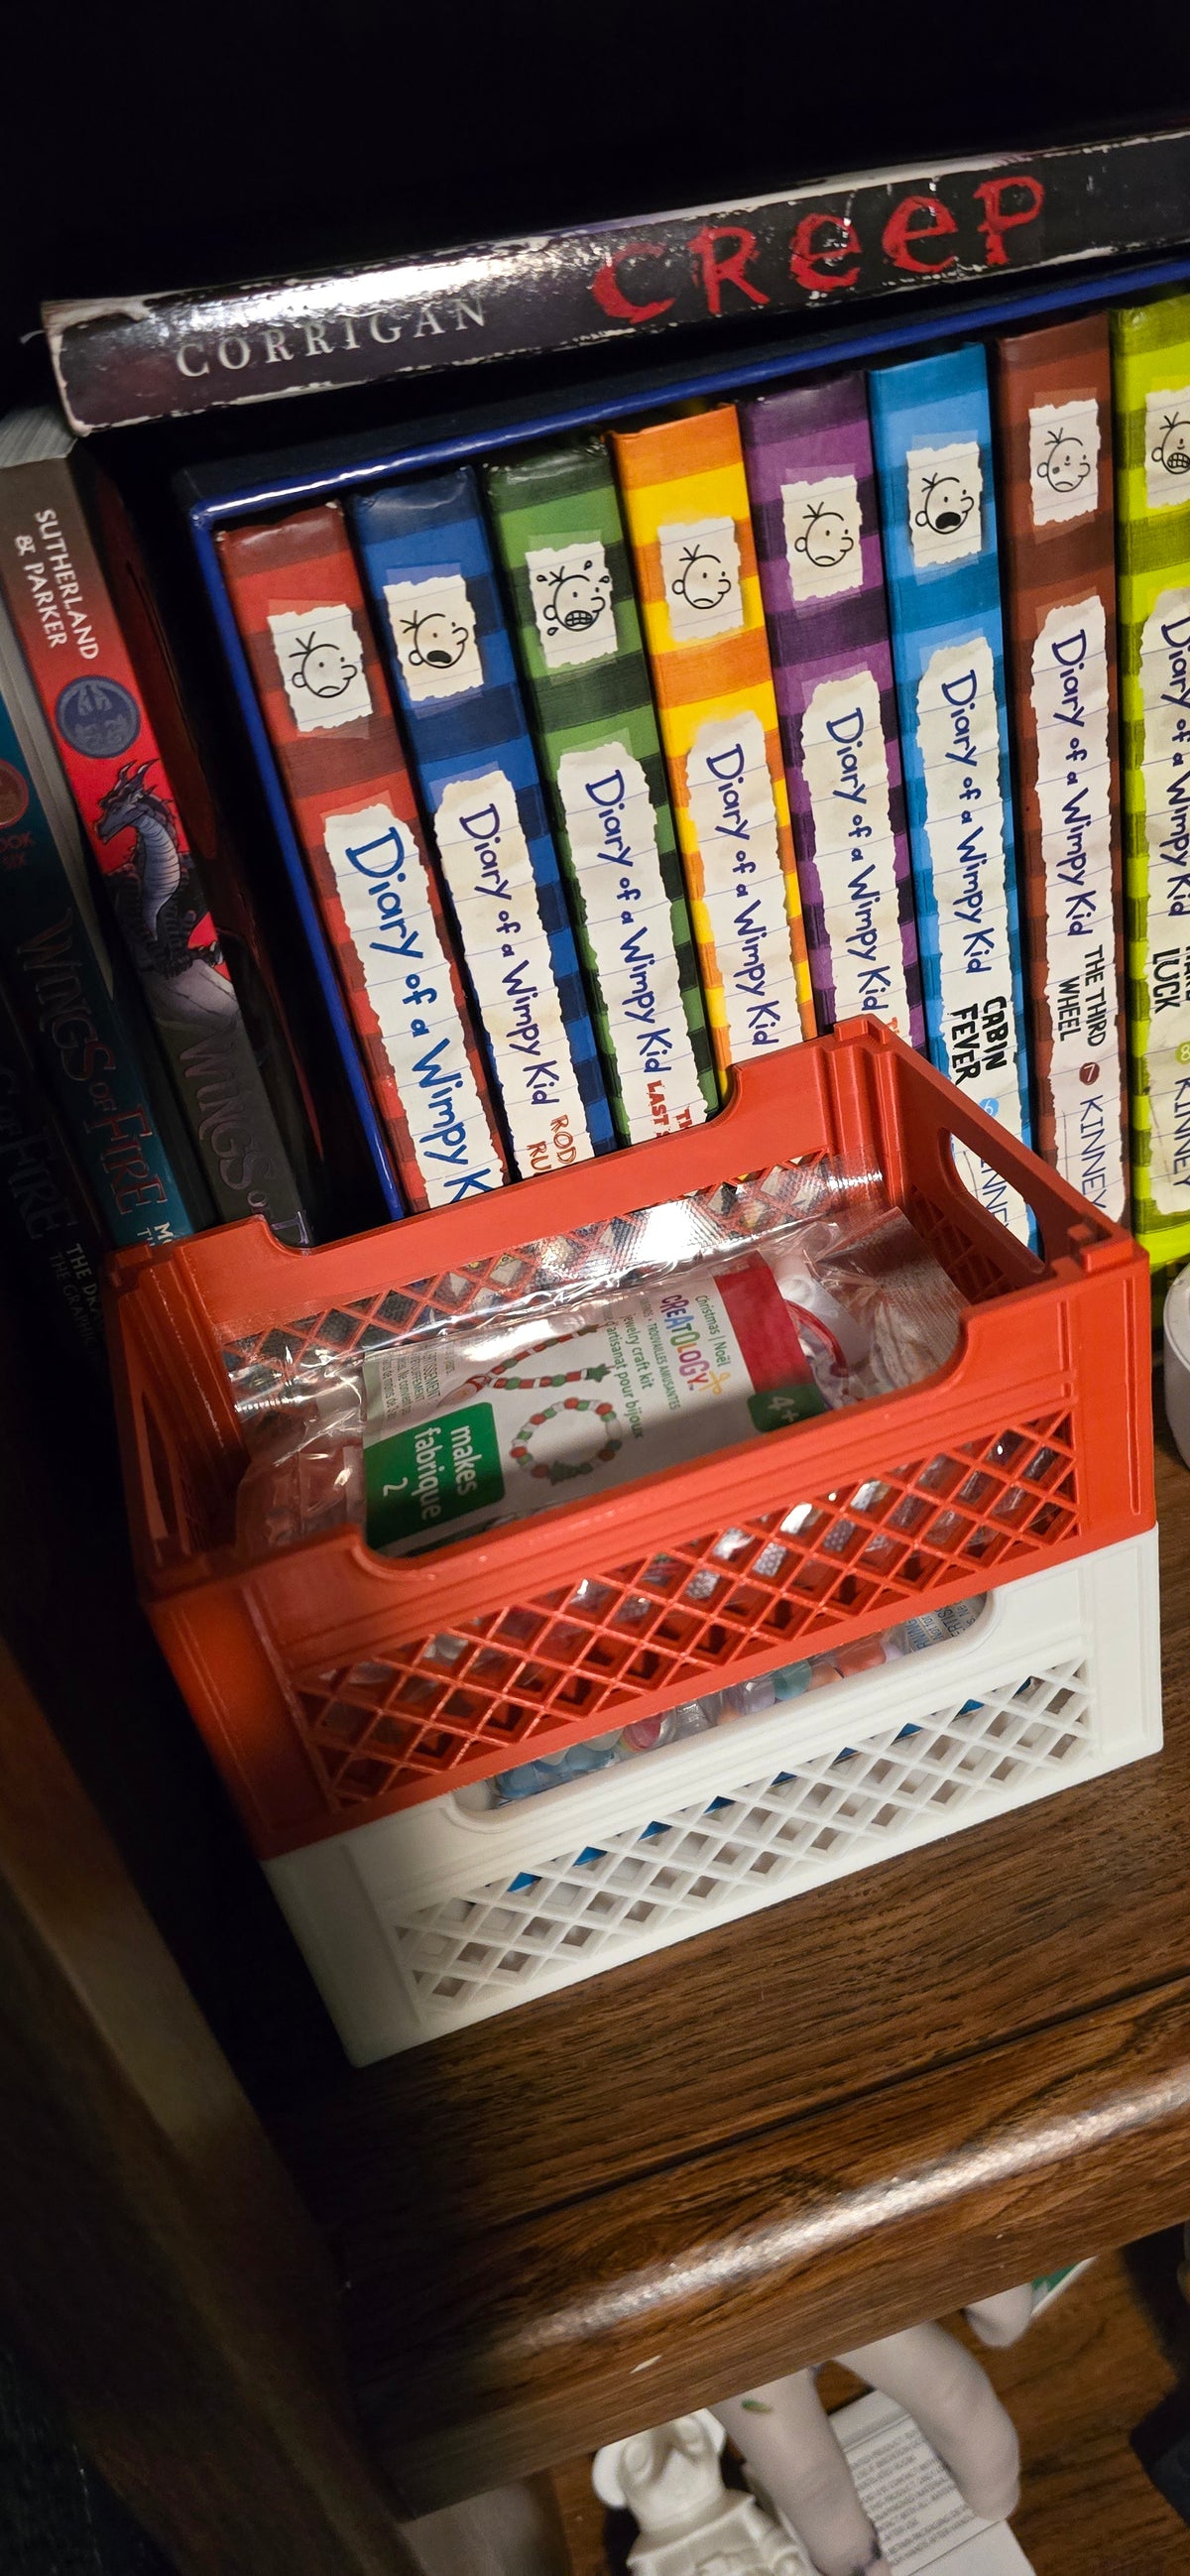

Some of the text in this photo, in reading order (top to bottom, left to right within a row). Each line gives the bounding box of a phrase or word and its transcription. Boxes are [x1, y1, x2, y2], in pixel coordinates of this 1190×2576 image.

[177, 299, 487, 378] CORRIGAN
[15, 536, 66, 648] & PARKER
[35, 509, 98, 661] SUTHERLAND
[1051, 629, 1097, 936] Diary of a Wimpy Kid
[1159, 617, 1190, 916] Diary of a Wimpy Kid
[826, 706, 892, 1012] Diary of a Wimpy Kid
[941, 669, 995, 974] Diary of a Wimpy Kid
[345, 826, 424, 958] Diary
[585, 769, 672, 1073] Diary of a Wimpy Kid
[706, 743, 781, 1046] Diary of a Wimpy Kid
[403, 973, 438, 1005] of
[459, 802, 560, 1106] Diary of a Wimpy Kid
[1084, 944, 1108, 1047] THE THIRD
[1152, 947, 1181, 1015] LUCK
[411, 1019, 430, 1038] a
[949, 1003, 982, 1085] FEVER
[981, 995, 1010, 1071] CABIN
[1057, 976, 1082, 1042] WHEEL
[17, 907, 117, 1082] WINGS
[83, 1102, 169, 1216] FIRE
[413, 1038, 469, 1165] Wimpy
[647, 1079, 670, 1126] LAST
[1083, 1062, 1096, 1081] 7
[179, 1025, 276, 1191] WINGS
[984, 1099, 996, 1116] 6
[1080, 1094, 1108, 1209] KINNEY
[606, 1320, 628, 1370] d'artisanat
[620, 1313, 654, 1389] jewelry craft kit
[647, 1322, 667, 1365] TROUVAILLES
[658, 1365, 680, 1410] AMUSANTES
[659, 1294, 710, 1384] CREATOLOGY
[695, 1294, 731, 1367] Christmas Noël
[614, 1371, 634, 1399] pour
[624, 1400, 644, 1439] bijoux
[383, 1478, 408, 1496] 2
[413, 1427, 442, 1521] fabrique
[451, 1425, 482, 1496] makes
